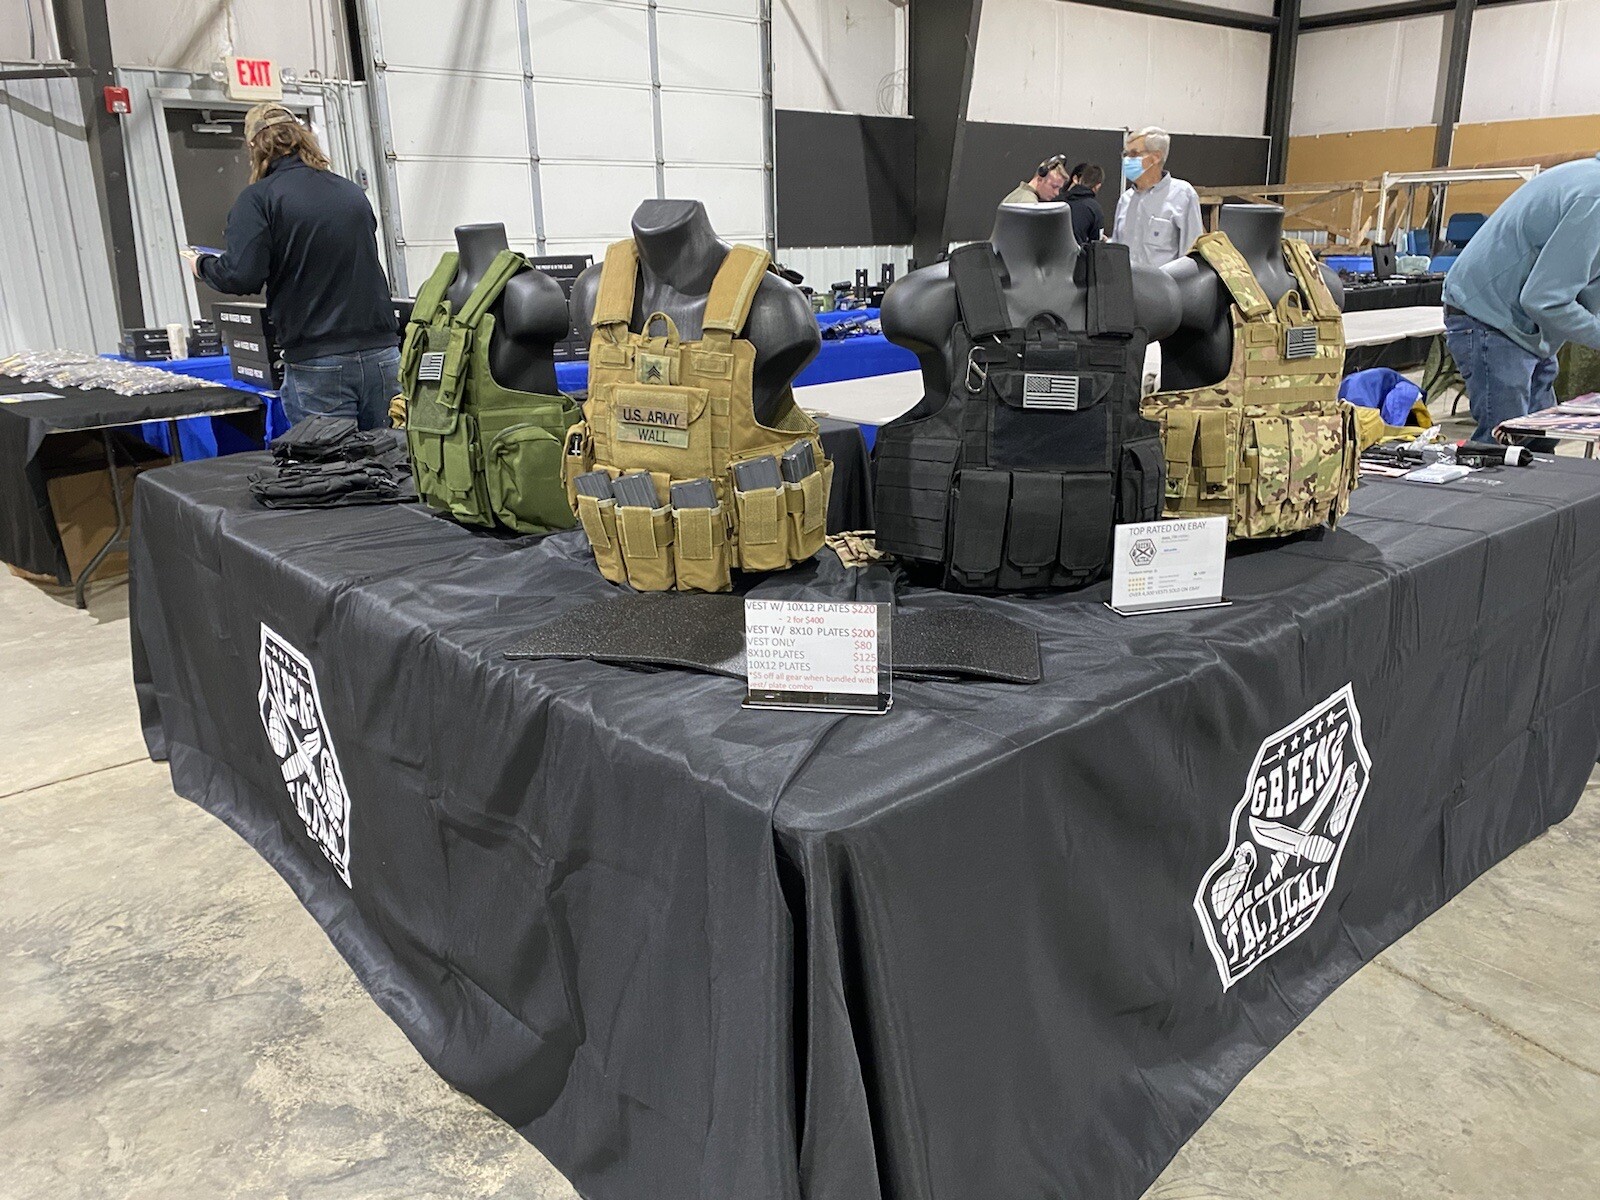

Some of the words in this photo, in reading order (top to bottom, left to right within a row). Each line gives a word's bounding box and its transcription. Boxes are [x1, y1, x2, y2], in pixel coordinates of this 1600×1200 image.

[236, 58, 271, 87] EXIT
[623, 408, 644, 422] U.S.
[647, 410, 680, 426] ARMY
[638, 427, 669, 443] WALL
[1129, 527, 1146, 536] TOP
[1146, 524, 1172, 535] RATED
[1172, 523, 1186, 532] ON
[1187, 521, 1207, 531] EBAY
[745, 601, 768, 611] VEST
[769, 602, 785, 612] W/
[787, 602, 815, 613] 10X12
[817, 603, 850, 614] PLATES
[851, 604, 876, 614] $220
[793, 616, 804, 624] for
[805, 617, 825, 625] $400
[746, 625, 769, 635] VEST
[770, 626, 786, 636] W/
[789, 627, 813, 636] 8X10
[817, 627, 850, 638] PLATES
[851, 628, 876, 639] $200
[747, 637, 769, 647] VEST
[771, 638, 796, 647] ONLY
[854, 641, 873, 650] $80
[747, 649, 771, 659] 8X10
[772, 650, 805, 660] PLATES
[853, 652, 877, 662] $125
[748, 660, 776, 670] 10X12
[778, 661, 811, 672] PLATES
[854, 664, 878, 674] $150
[764, 672, 775, 680] off
[776, 673, 785, 681] all
[785, 674, 802, 683] gear
[803, 674, 825, 683] when
[826, 675, 857, 684] bundled
[858, 676, 876, 685] with
[768, 681, 788, 691] plate
[788, 682, 814, 691] combo
[1226, 864, 1325, 966] TACTICAL
